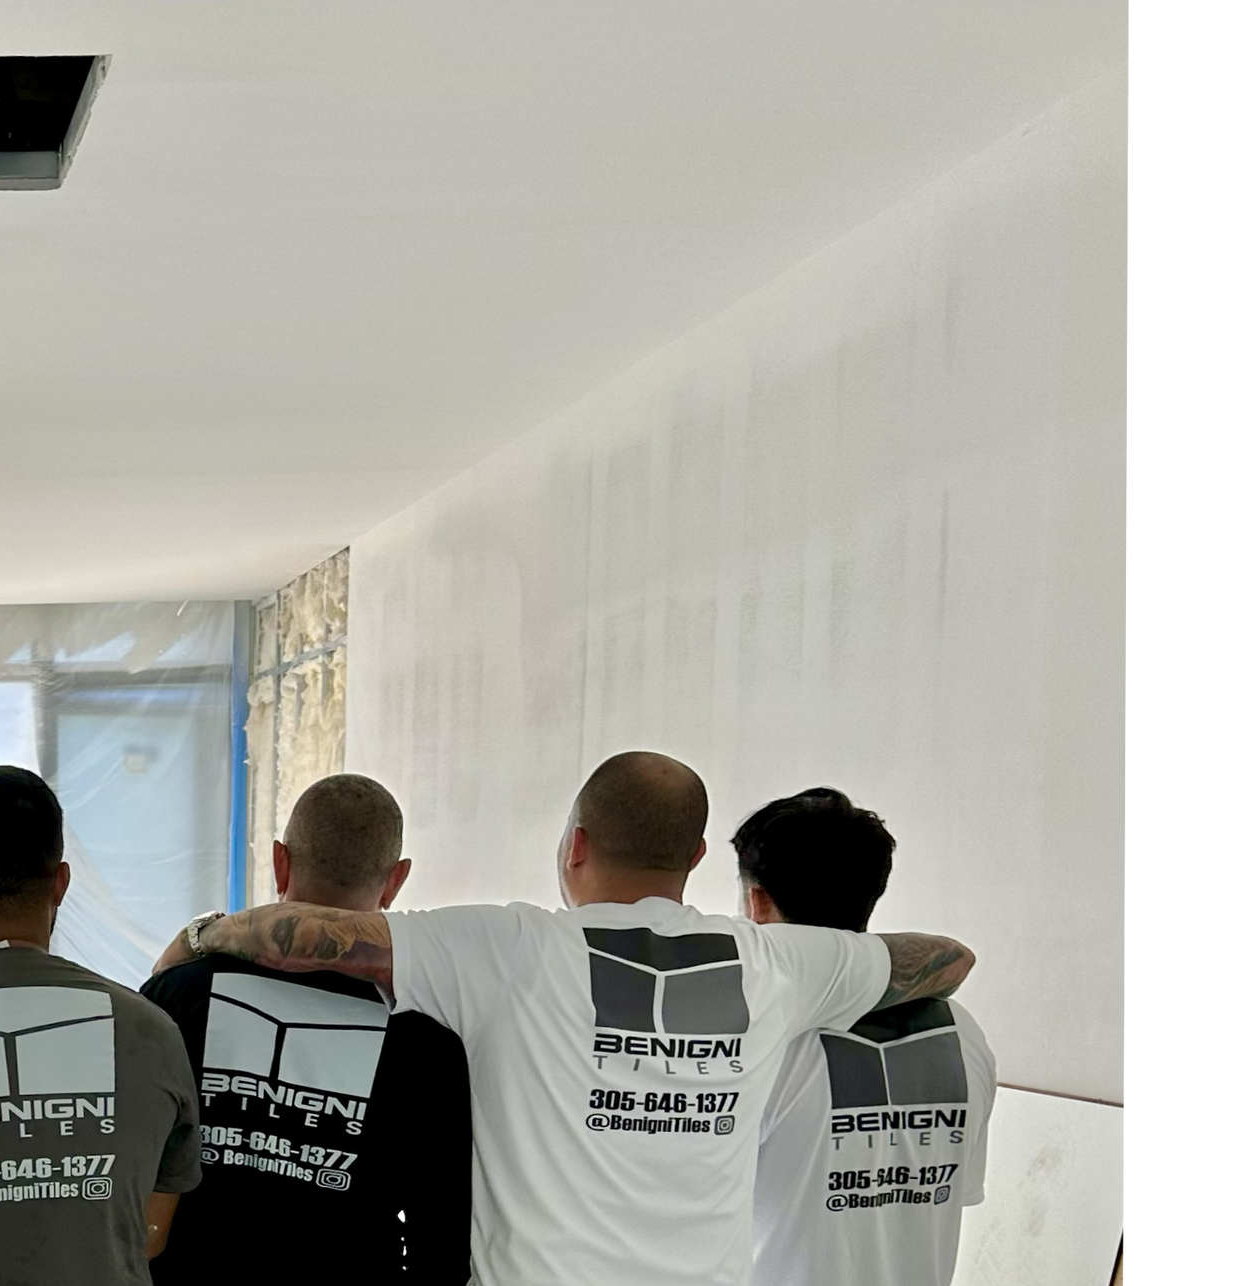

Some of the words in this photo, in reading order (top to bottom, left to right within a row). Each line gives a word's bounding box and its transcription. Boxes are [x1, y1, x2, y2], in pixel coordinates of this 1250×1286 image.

[593, 1033, 743, 1059] BENIGNI
[592, 1055, 744, 1075] TILES
[201, 1072, 368, 1121] BENIGNI
[588, 1088, 740, 1114] 305-646-1377
[201, 1093, 363, 1135] TILES
[586, 1113, 711, 1135] @BenigniTiles
[831, 1109, 967, 1134] BENIGNI
[200, 1125, 359, 1171] 305-646-1377
[831, 1130, 965, 1150] TILES
[828, 1164, 959, 1191] 305-646-1377
